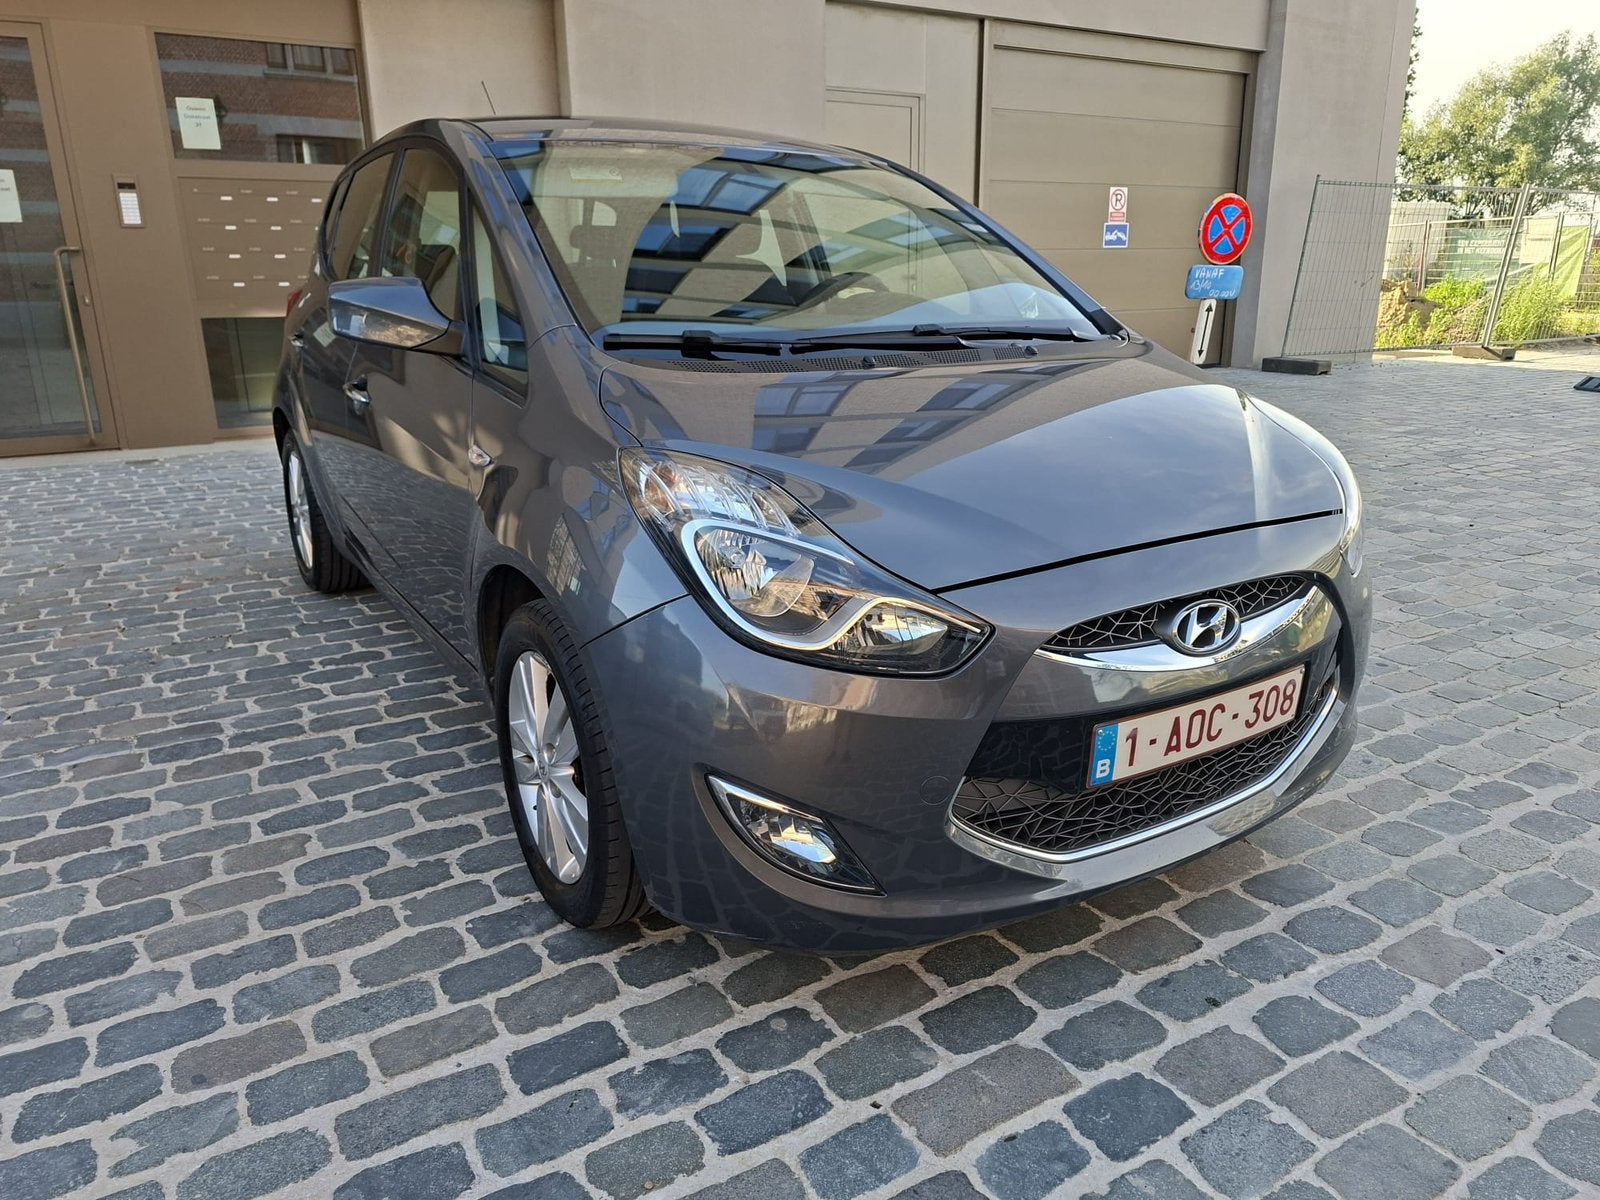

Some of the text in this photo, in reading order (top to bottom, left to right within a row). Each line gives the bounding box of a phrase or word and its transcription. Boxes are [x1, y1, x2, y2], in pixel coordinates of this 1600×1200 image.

[1195, 267, 1225, 279] VANAF
[1125, 678, 1297, 767] 1-AOC-308
[1095, 758, 1111, 779] B
